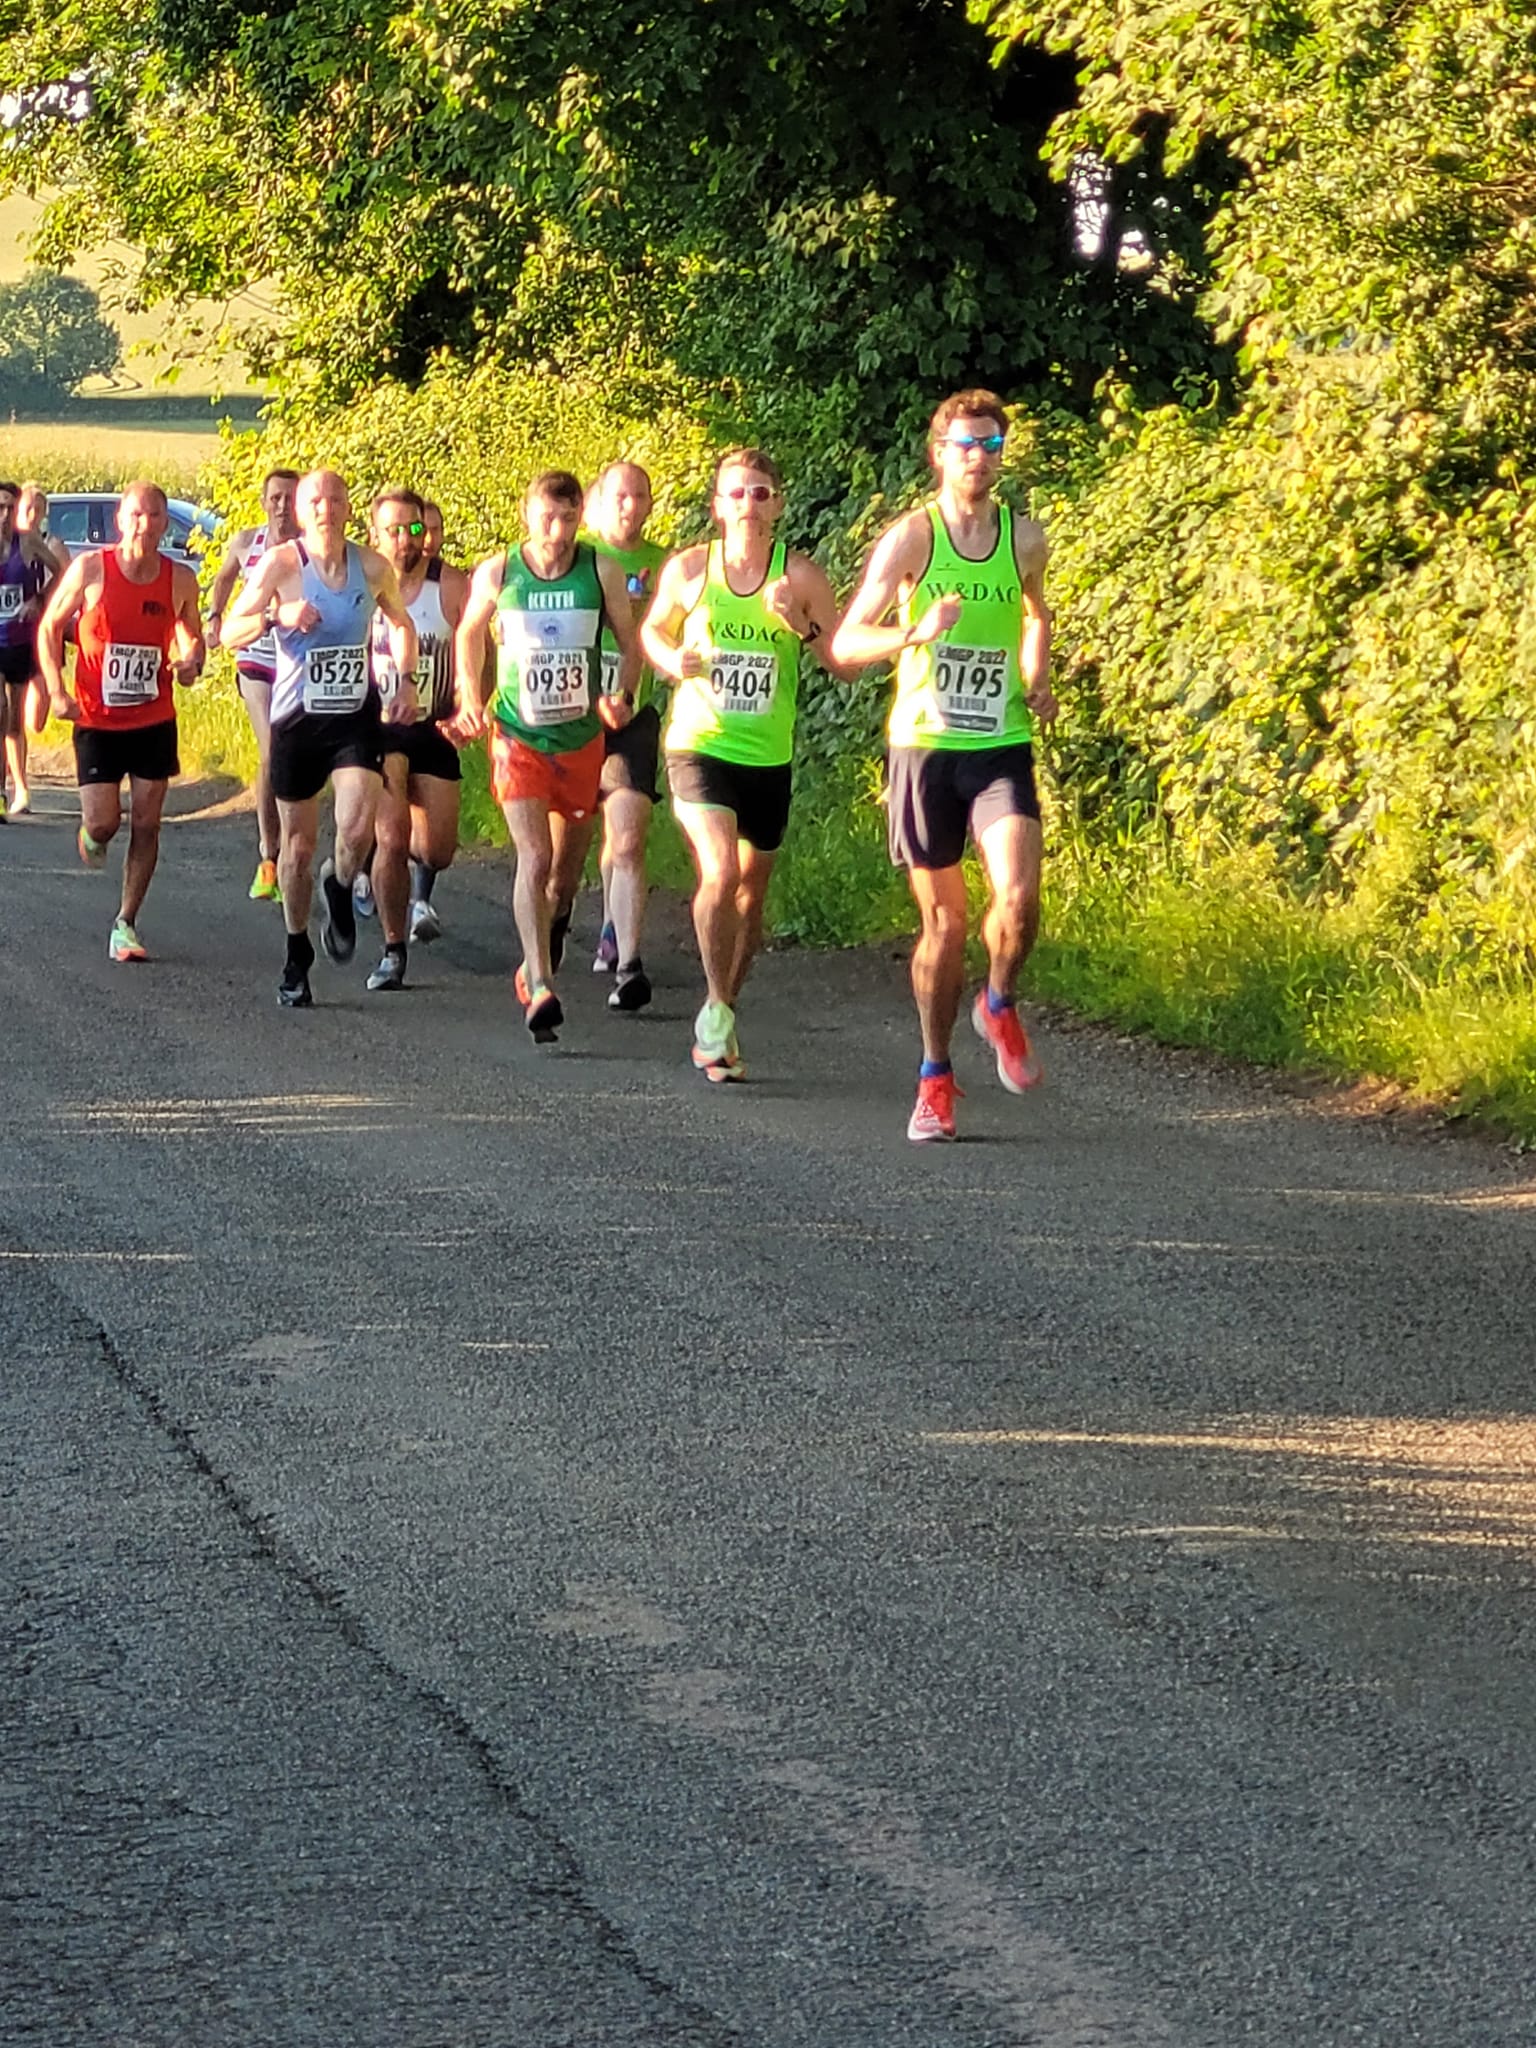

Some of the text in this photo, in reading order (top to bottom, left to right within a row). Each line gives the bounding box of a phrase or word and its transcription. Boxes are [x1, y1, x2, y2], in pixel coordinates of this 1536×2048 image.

[109, 658, 156, 681] 0145
[310, 661, 364, 684] 0522
[526, 666, 582, 693] 0933
[936, 663, 1004, 698] 0195
[380, 672, 429, 694] 017
[711, 668, 771, 699] 0404
